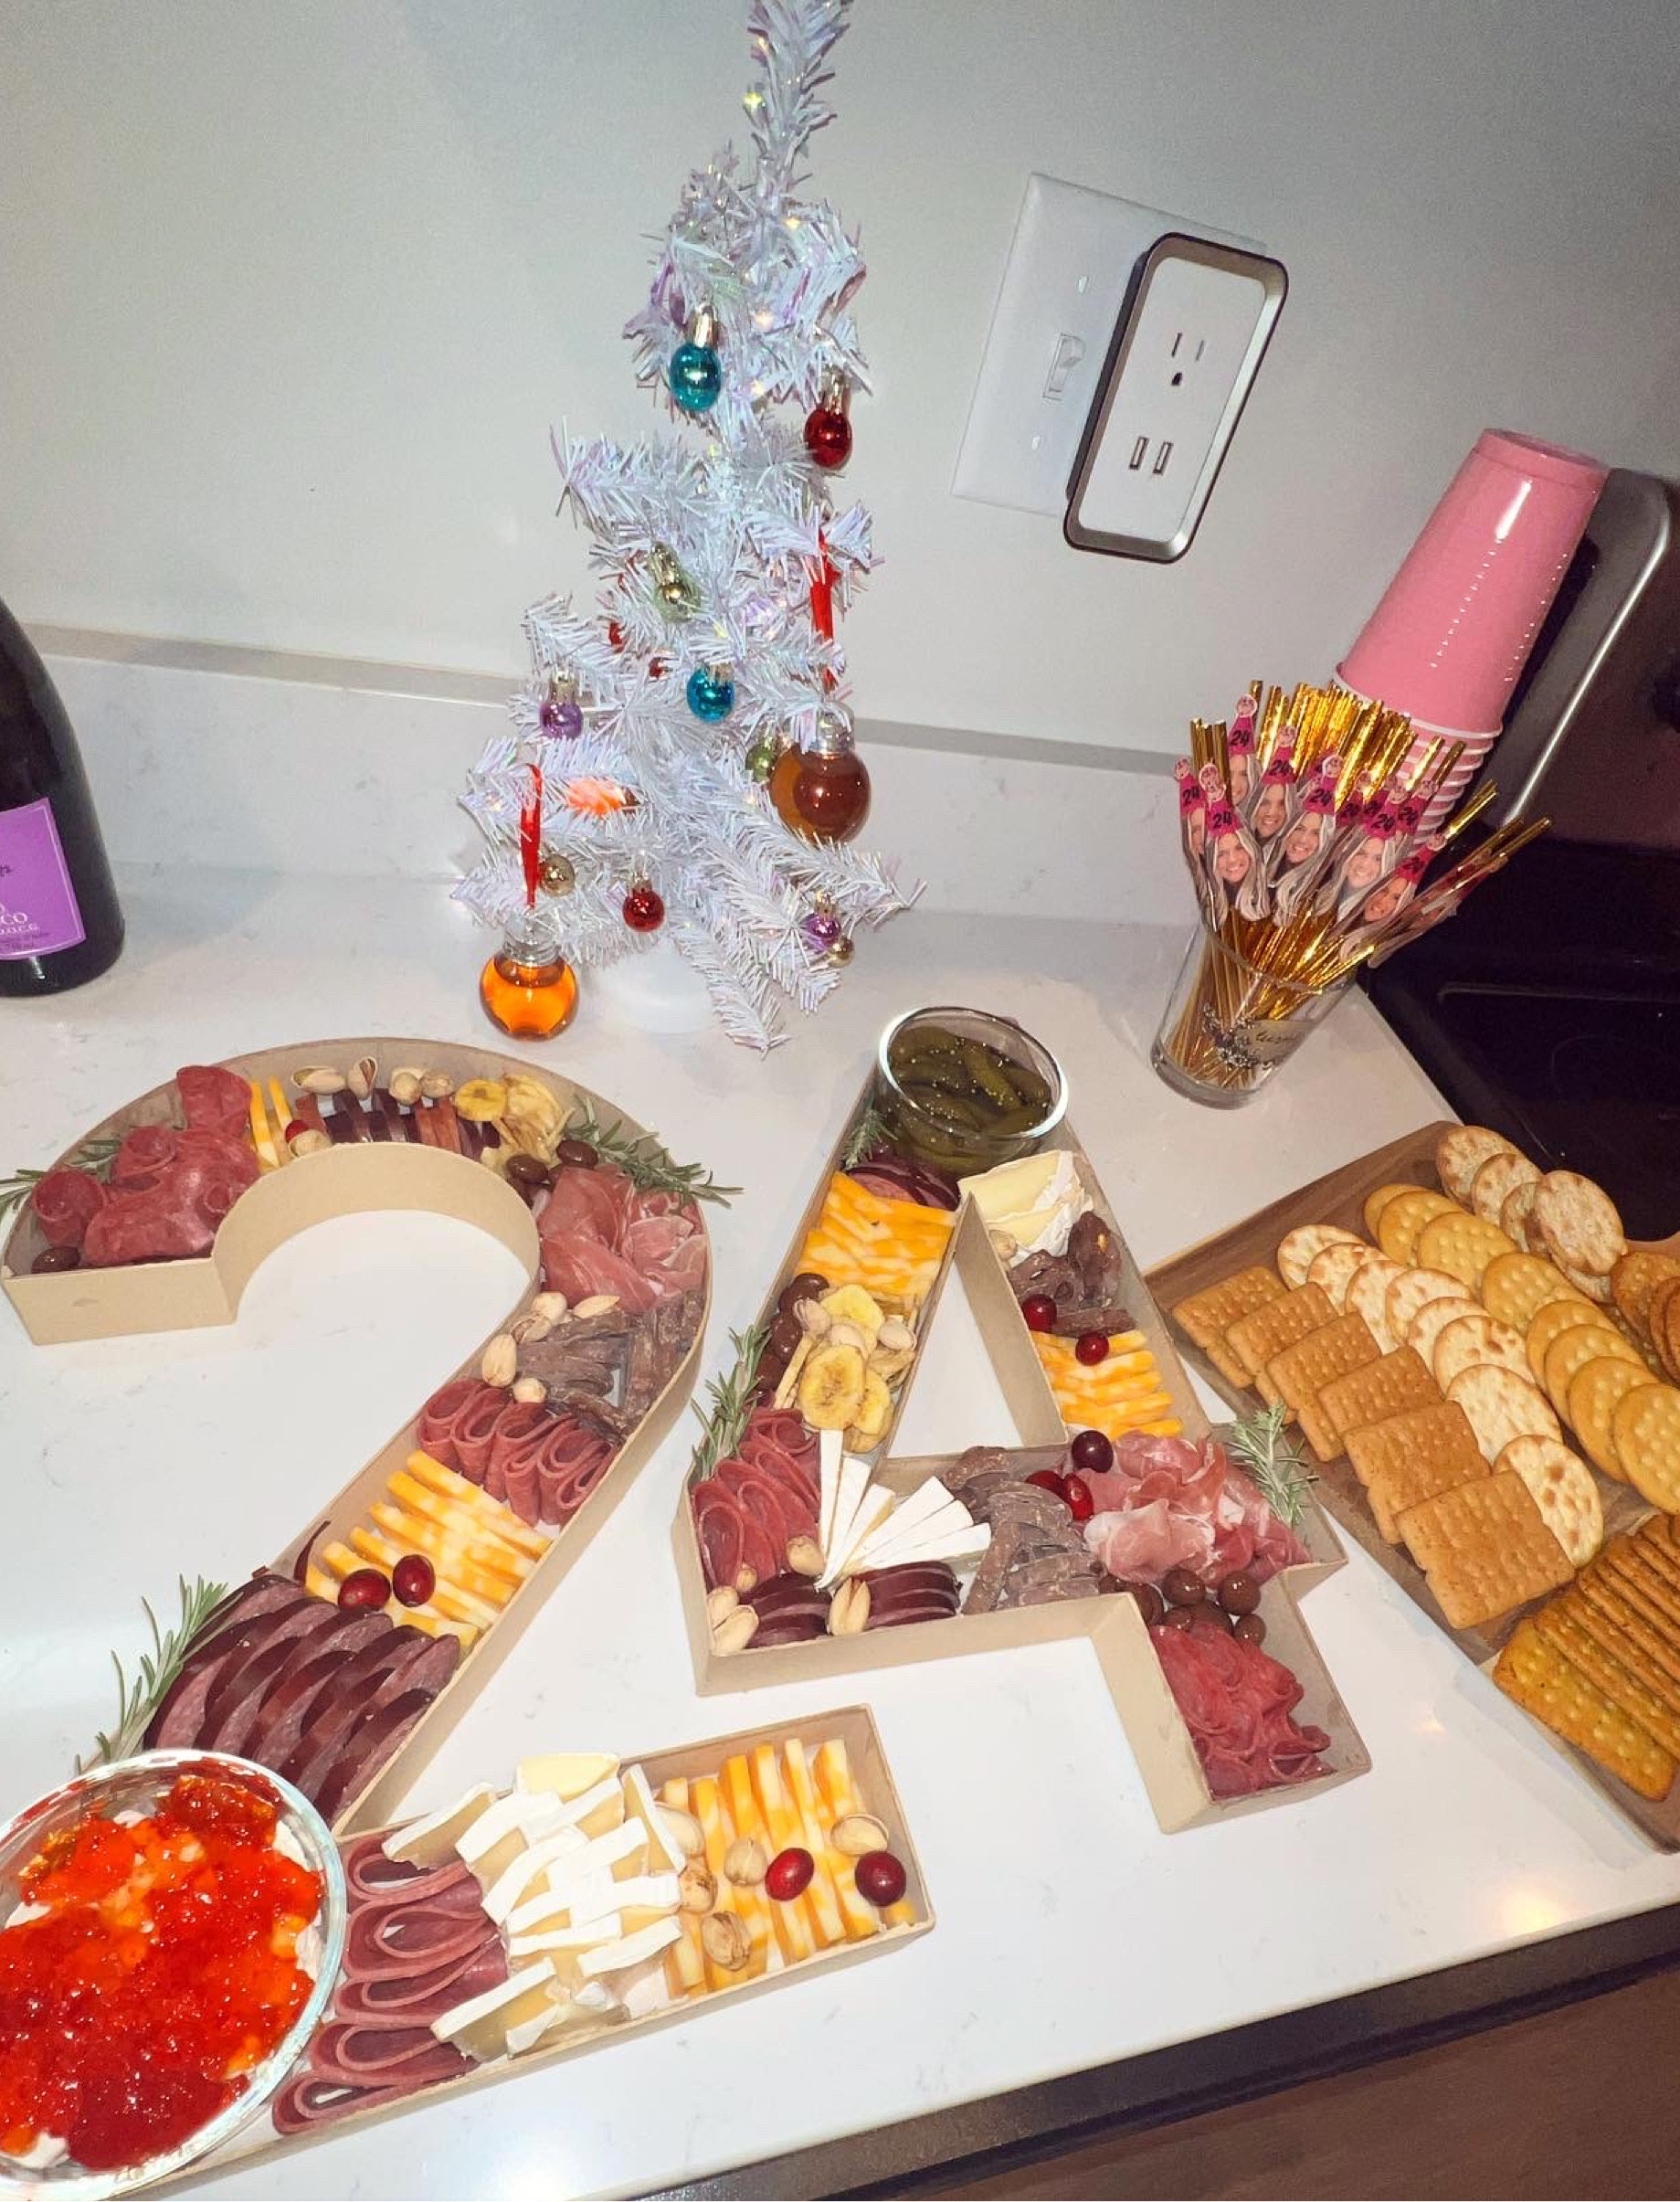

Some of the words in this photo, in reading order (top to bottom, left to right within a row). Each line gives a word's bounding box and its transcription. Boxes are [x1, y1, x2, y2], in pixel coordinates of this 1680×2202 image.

[1230, 730, 1250, 746] 24
[1270, 759, 1292, 776] 24
[1183, 786, 1199, 805] 24
[1309, 789, 1332, 807] 24
[1212, 811, 1232, 829] 24
[1370, 813, 1394, 831] 24
